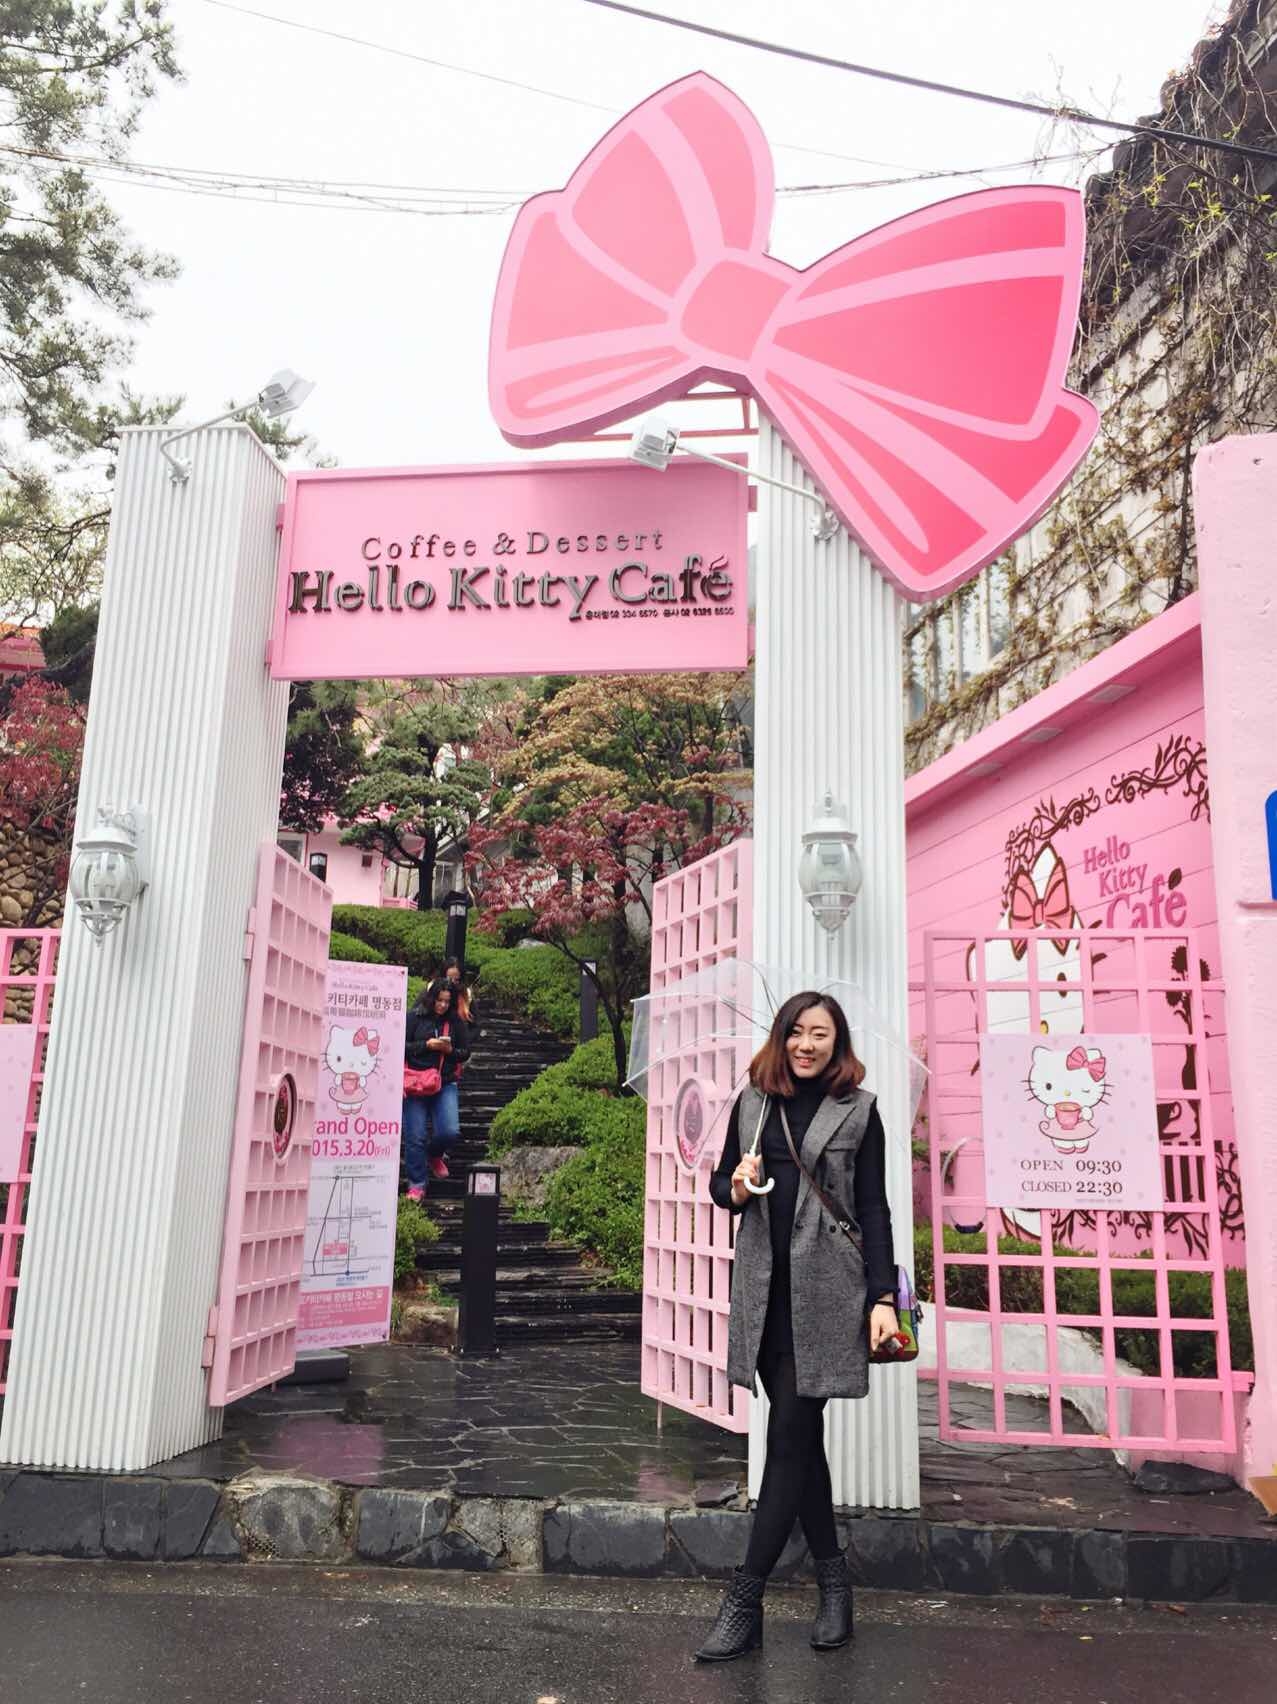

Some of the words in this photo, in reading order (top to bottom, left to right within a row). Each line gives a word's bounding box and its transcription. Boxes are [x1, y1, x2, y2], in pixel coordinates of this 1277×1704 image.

[361, 534, 477, 561] Coffee
[493, 532, 516, 556] &
[526, 530, 663, 555] Dessert
[288, 564, 436, 614] Hello
[448, 563, 599, 622] Kitty
[608, 553, 734, 606] Café
[1083, 835, 1130, 874] Hello
[1098, 863, 1148, 898] Kitty
[372, 996, 402, 1011] 명동점
[354, 1117, 399, 1138] Open
[1020, 1160, 1063, 1171] OPEN
[1075, 1160, 1122, 1175] 09:30
[1021, 1181, 1072, 1192] CLOSED
[1076, 1181, 1123, 1197] 22:30
